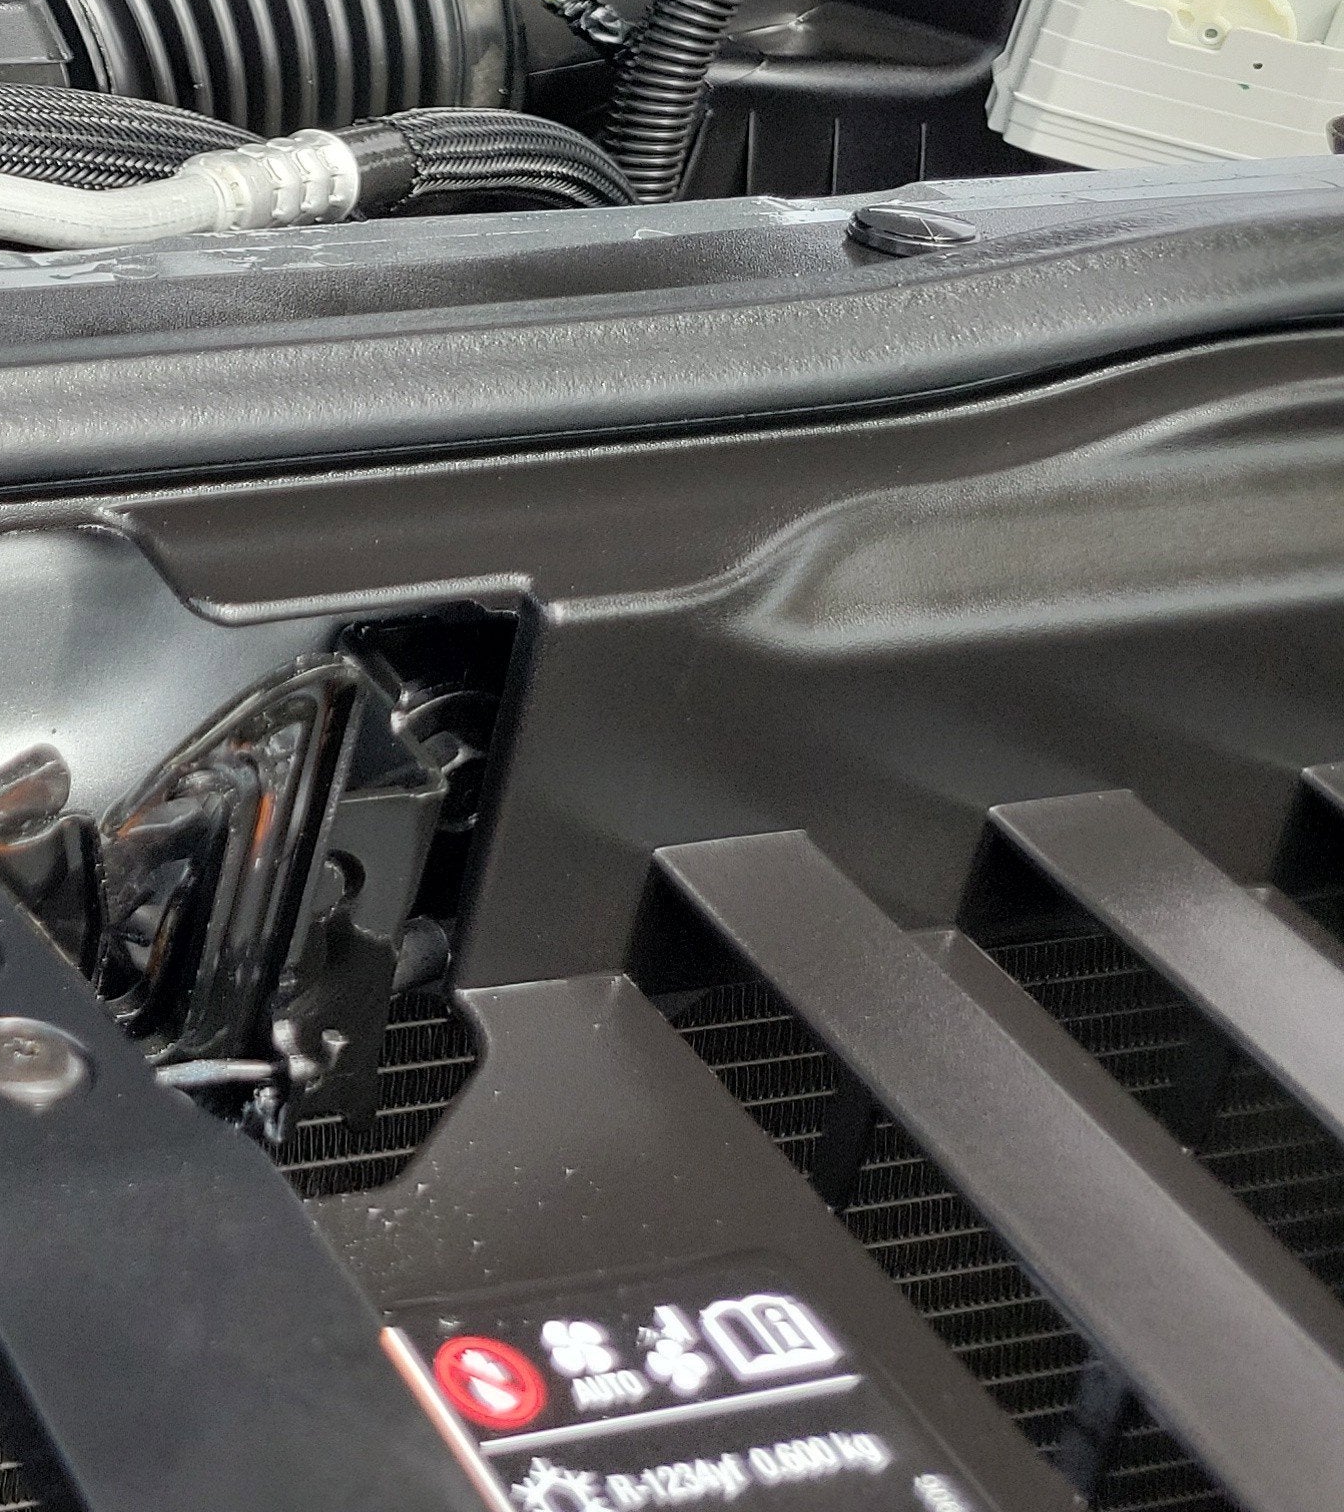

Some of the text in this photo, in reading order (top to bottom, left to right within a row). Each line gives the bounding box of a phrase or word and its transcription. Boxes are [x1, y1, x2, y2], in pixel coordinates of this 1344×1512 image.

[571, 1369, 646, 1405] AUTO
[605, 1431, 890, 1510] R-1234yf 0.600 kg
